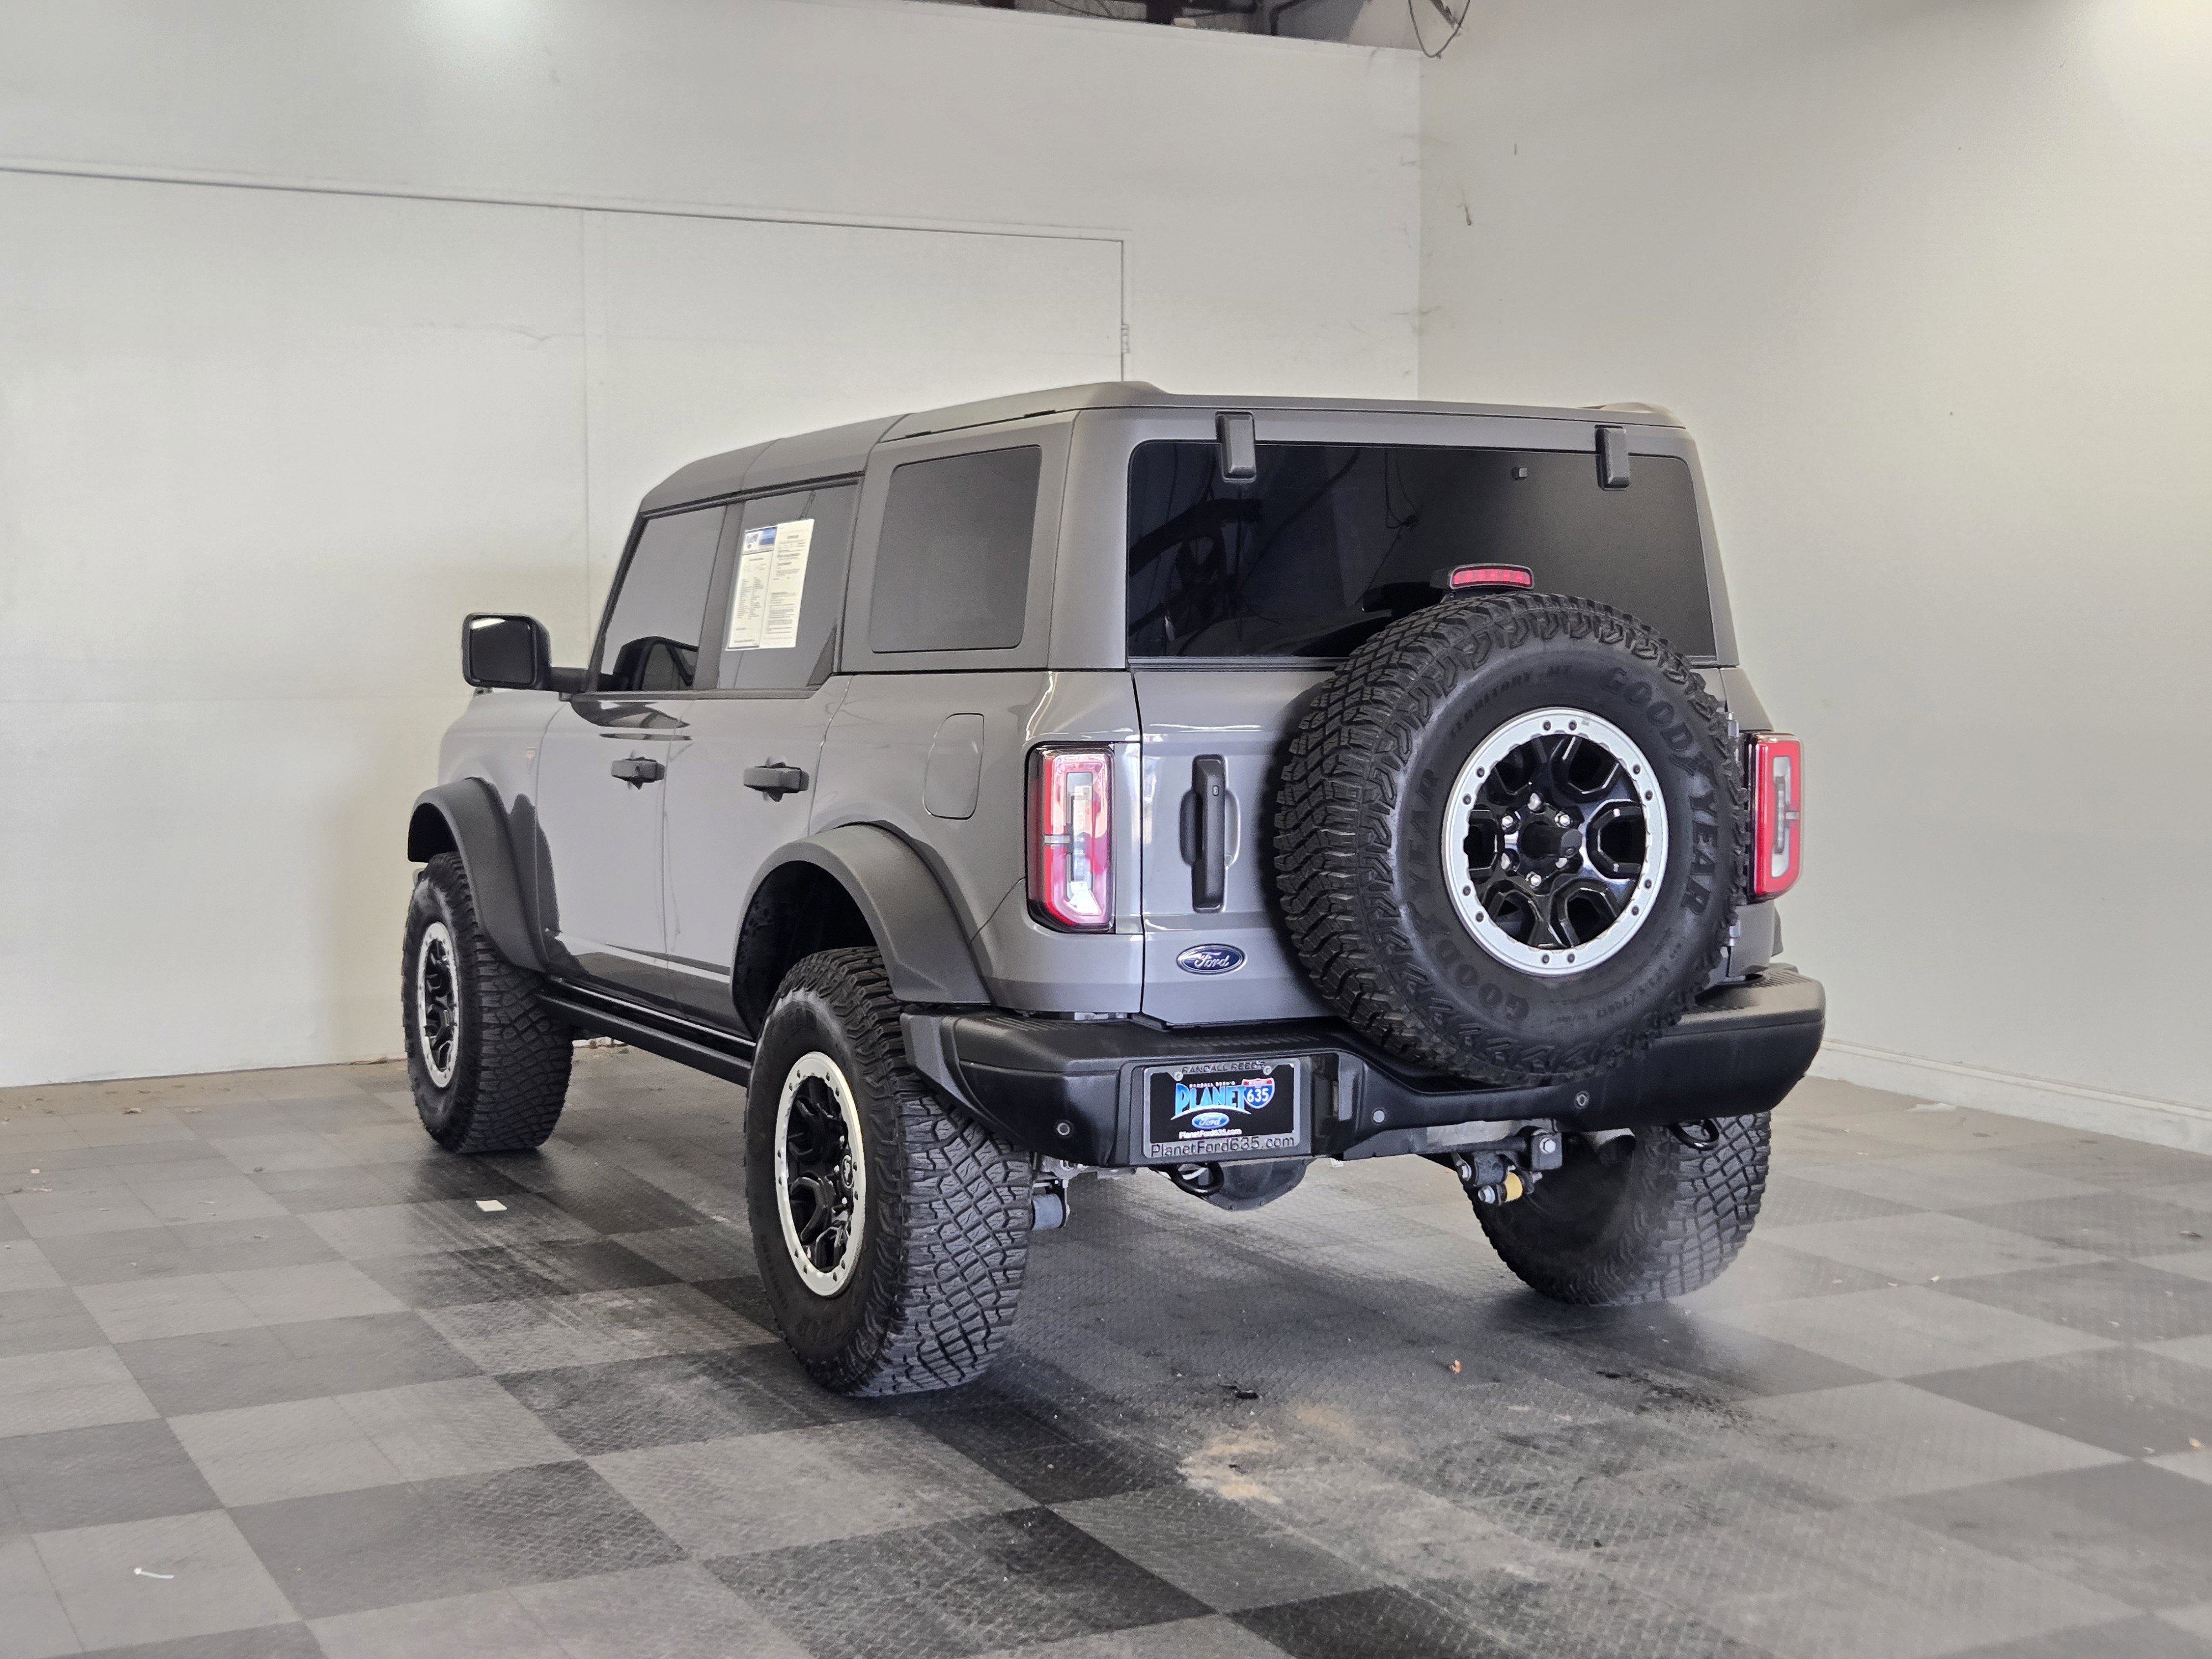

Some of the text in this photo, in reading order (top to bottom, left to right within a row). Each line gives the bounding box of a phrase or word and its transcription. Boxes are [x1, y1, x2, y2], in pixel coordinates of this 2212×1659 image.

[1600, 666, 1719, 916] GOODYEAR
[1194, 951, 1230, 968] Ford
[1181, 1063, 1228, 1074] RANDALL
[1175, 1082, 1270, 1117] PLANET 635
[1198, 1115, 1222, 1126] Ford
[1150, 1136, 1295, 1157] PlanetFord635.com
